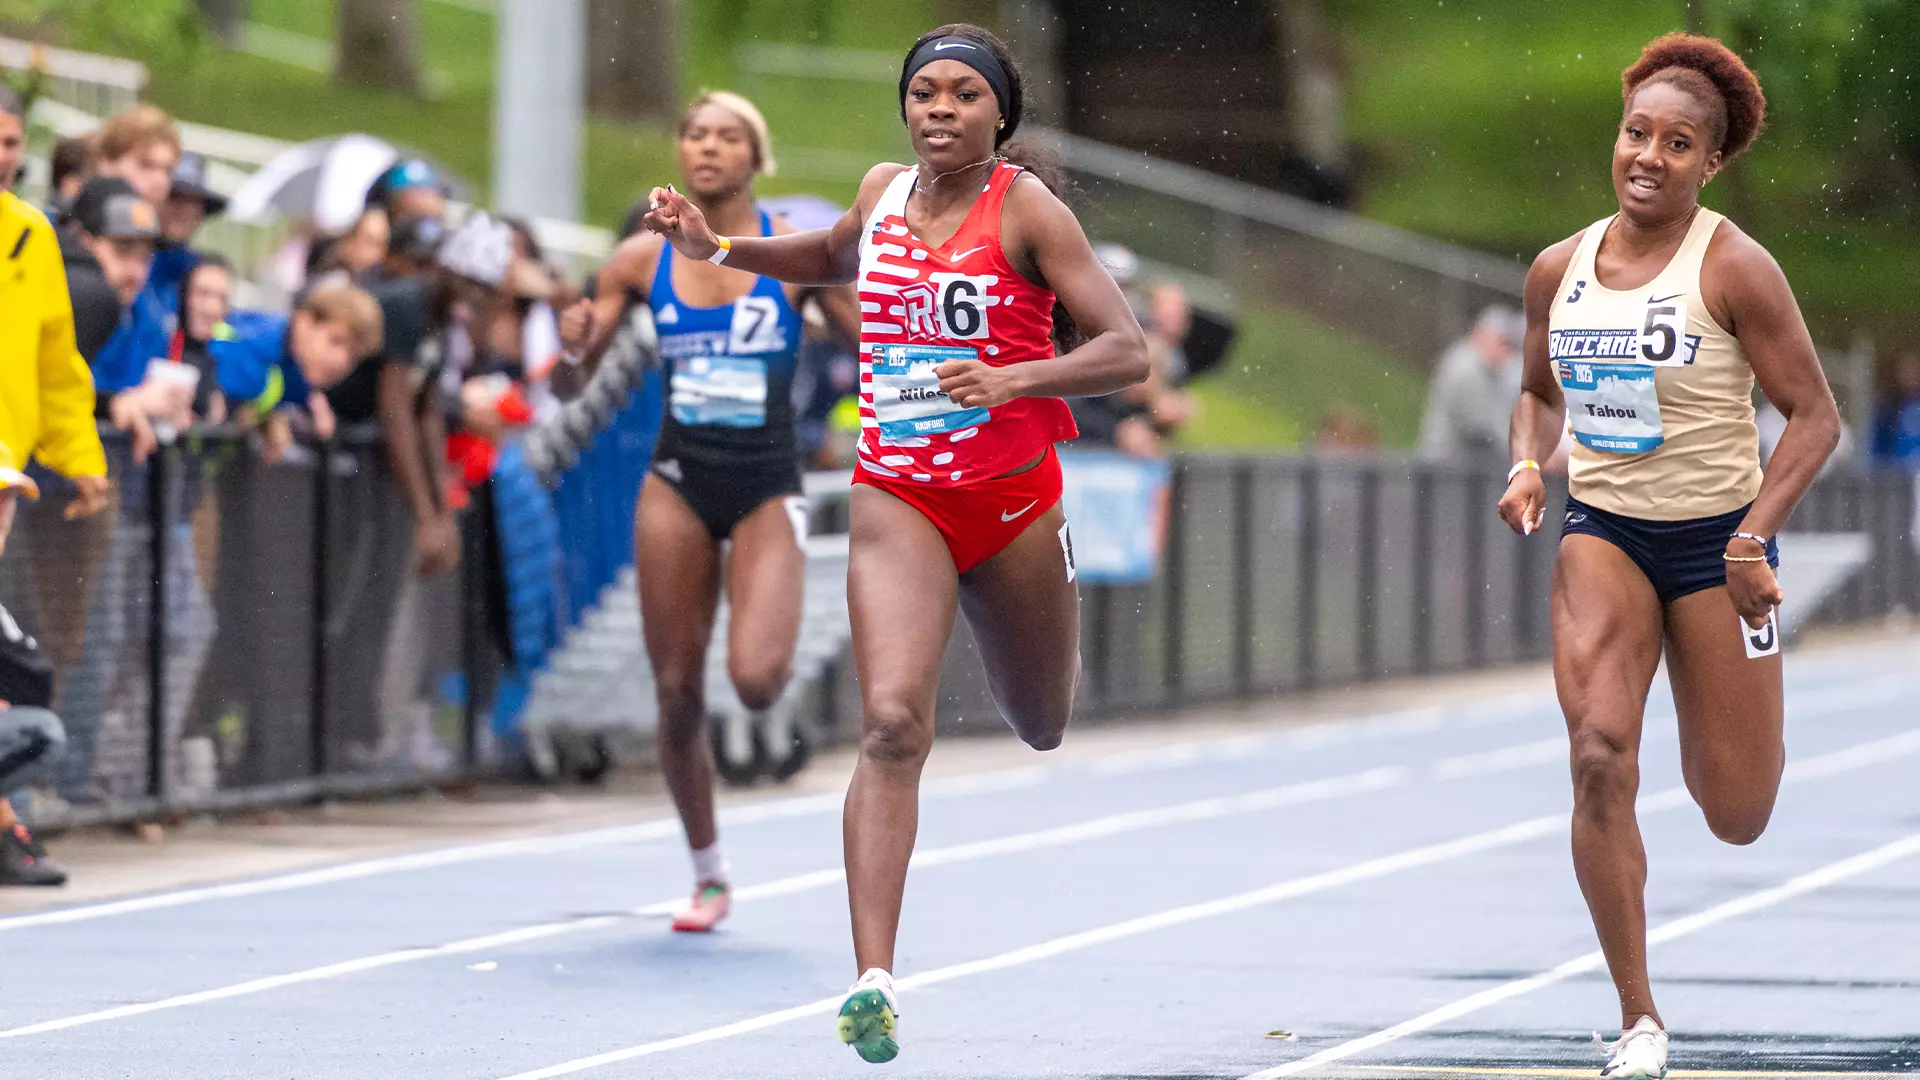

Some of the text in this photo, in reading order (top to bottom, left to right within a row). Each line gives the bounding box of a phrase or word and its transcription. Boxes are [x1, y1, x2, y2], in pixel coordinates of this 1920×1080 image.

[1566, 281, 1586, 303] S
[943, 280, 981, 337] 6
[745, 305, 768, 343] 7
[1641, 306, 1677, 362] 5
[888, 347, 907, 367] 2025
[1574, 363, 1593, 383] 2025
[1584, 403, 1637, 419] Tahou
[914, 418, 945, 431] RADFORD
